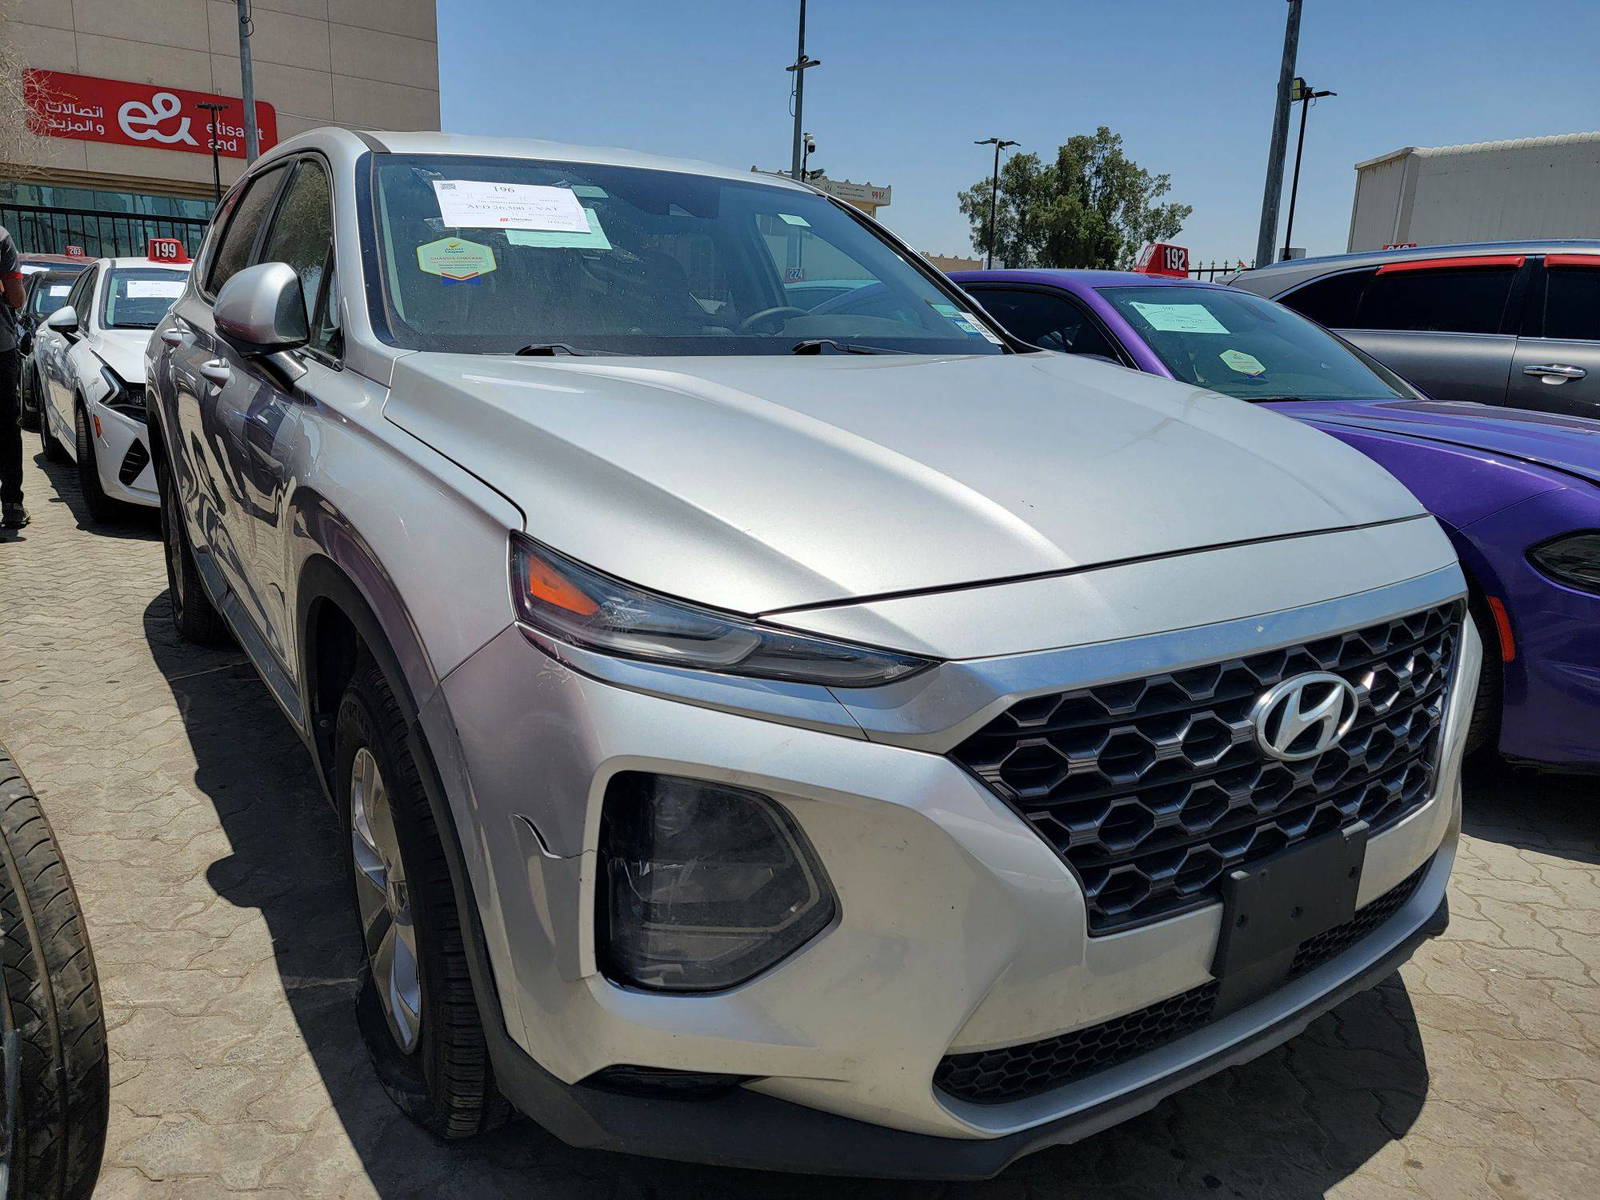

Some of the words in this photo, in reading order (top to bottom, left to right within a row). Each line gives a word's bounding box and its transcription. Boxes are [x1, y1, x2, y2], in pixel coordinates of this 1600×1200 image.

[45, 101, 104, 119] اتصالات
[206, 119, 265, 141] etisat
[494, 186, 516, 194] 196
[154, 242, 177, 259] 199
[1165, 247, 1186, 271] 192
